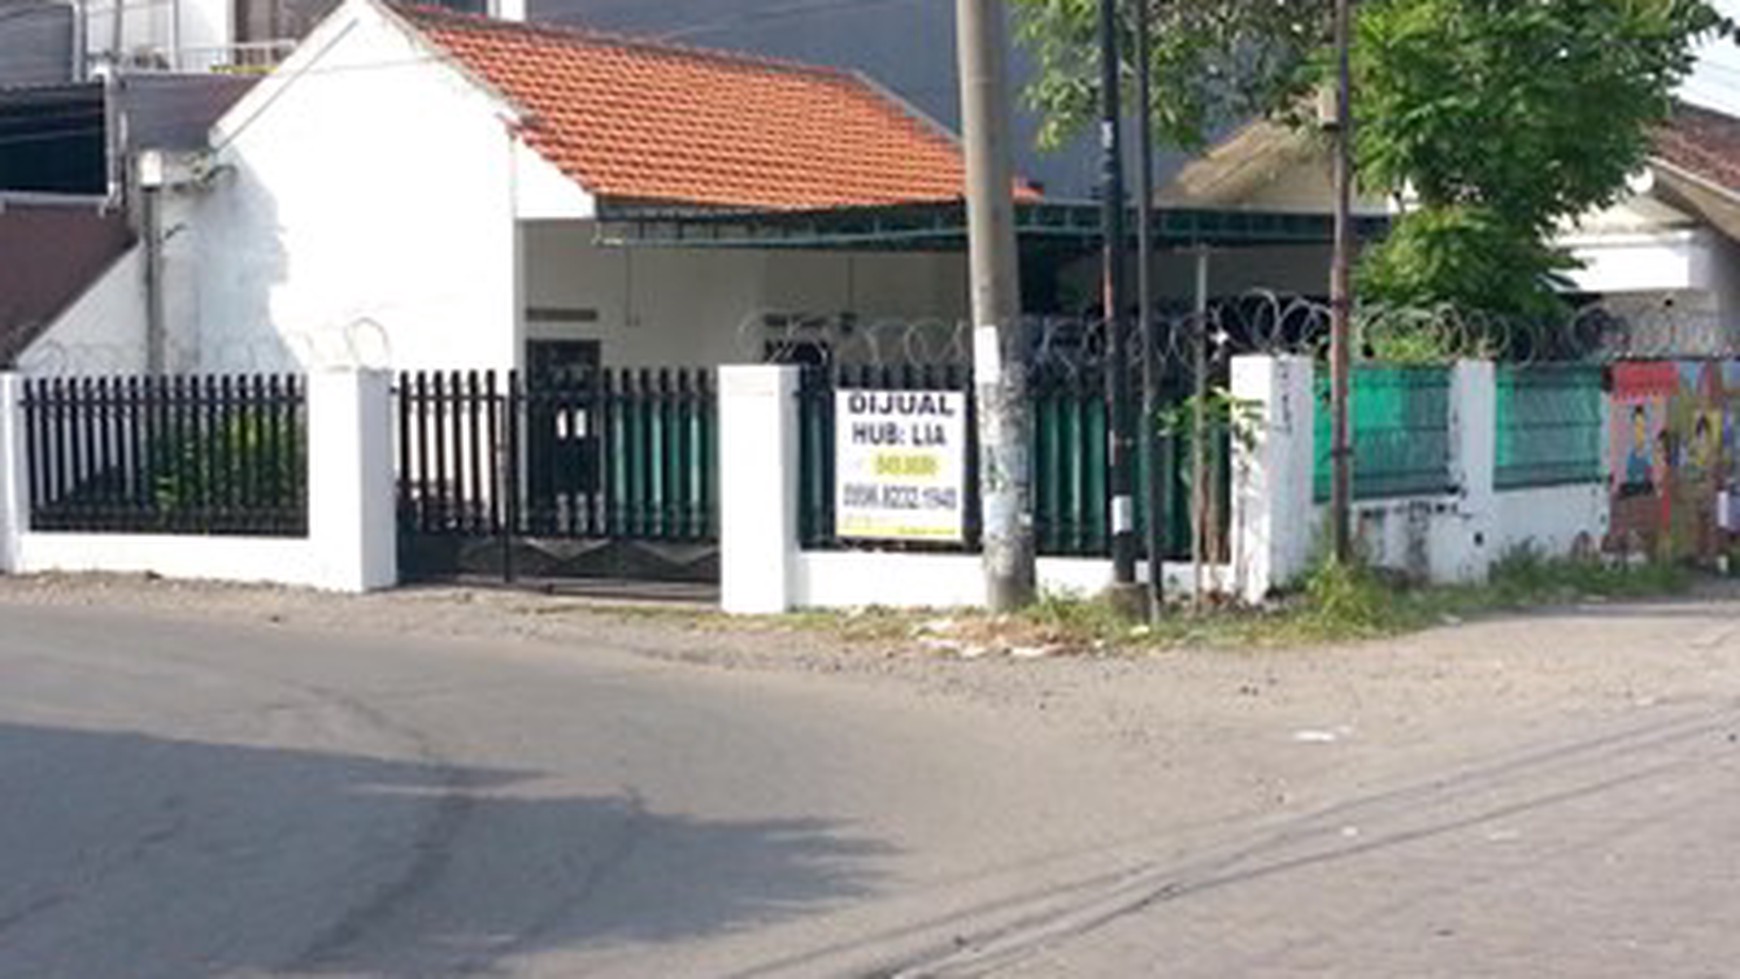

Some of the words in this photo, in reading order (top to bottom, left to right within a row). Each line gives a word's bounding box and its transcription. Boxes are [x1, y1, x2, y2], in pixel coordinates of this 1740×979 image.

[847, 391, 955, 415] DIJUAL
[852, 422, 905, 445] HUB:
[911, 424, 946, 446] LIA
